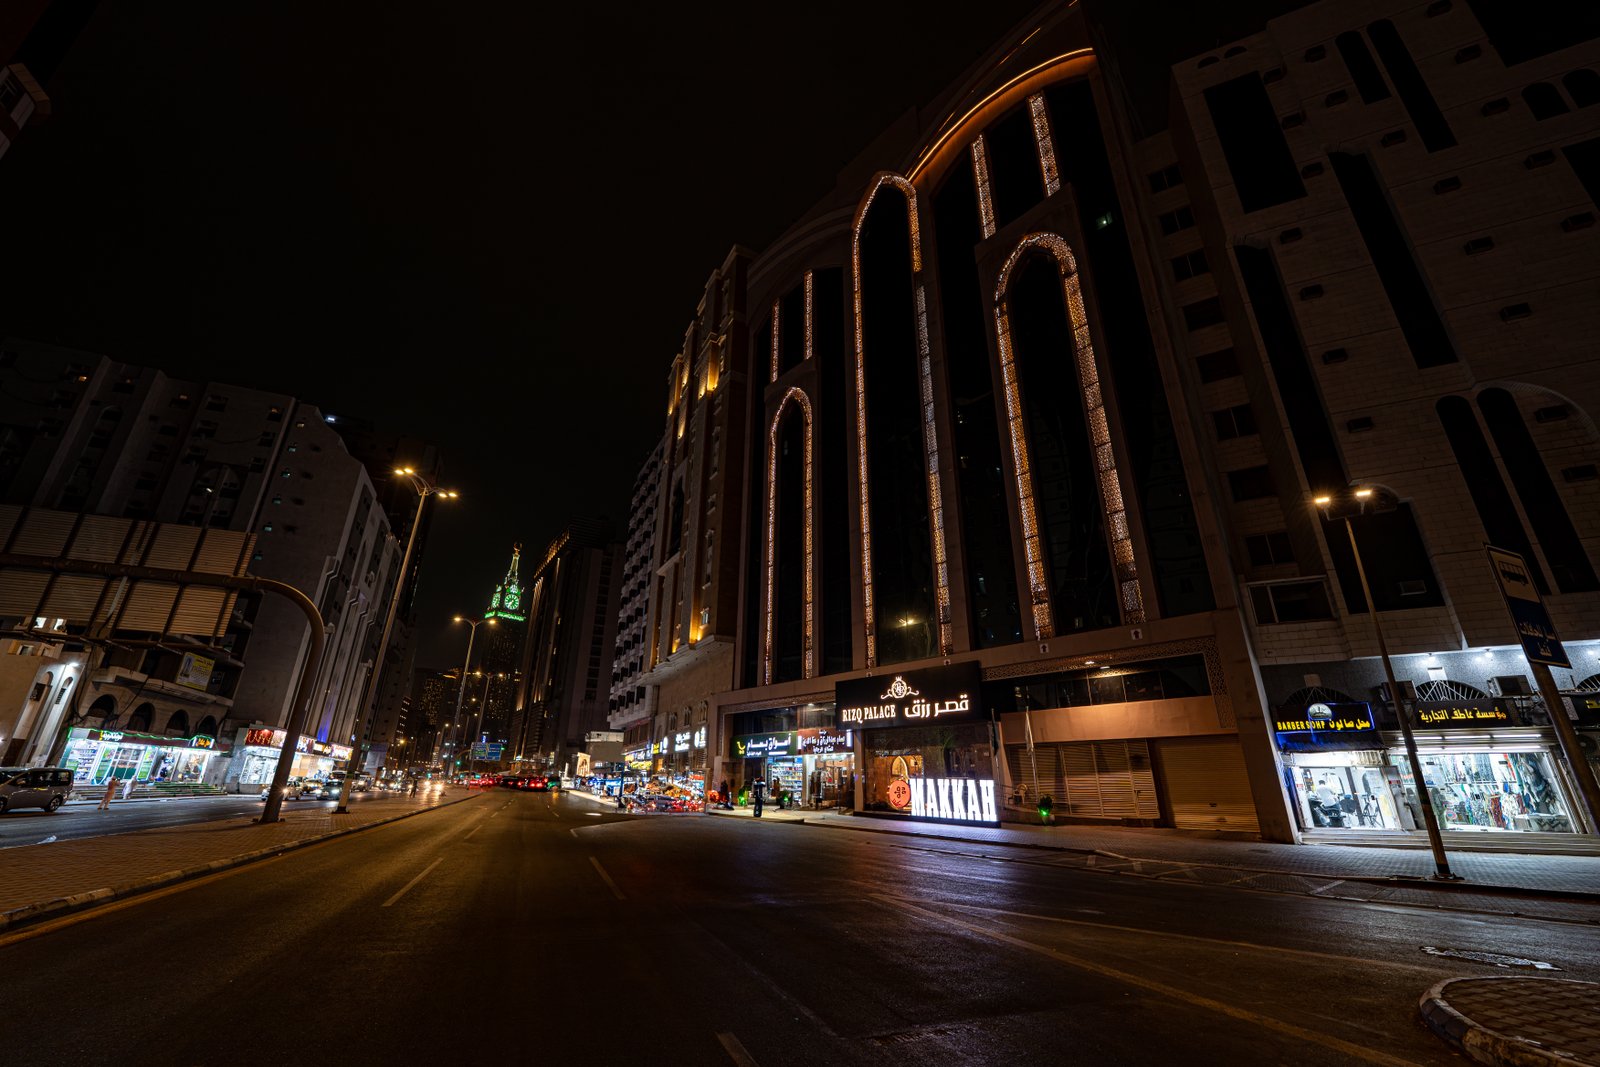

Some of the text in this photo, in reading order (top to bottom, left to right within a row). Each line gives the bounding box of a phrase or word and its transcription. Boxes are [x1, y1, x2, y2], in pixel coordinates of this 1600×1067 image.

[842, 704, 896, 723] RIZQ PALACE
[904, 694, 969, 718] قصر رزق
[1419, 706, 1506, 723] مؤسسة عاطف التجارية
[1356, 718, 1371, 730] محل
[746, 733, 792, 751] أسواق بسام
[909, 778, 998, 822] MAKKAH
